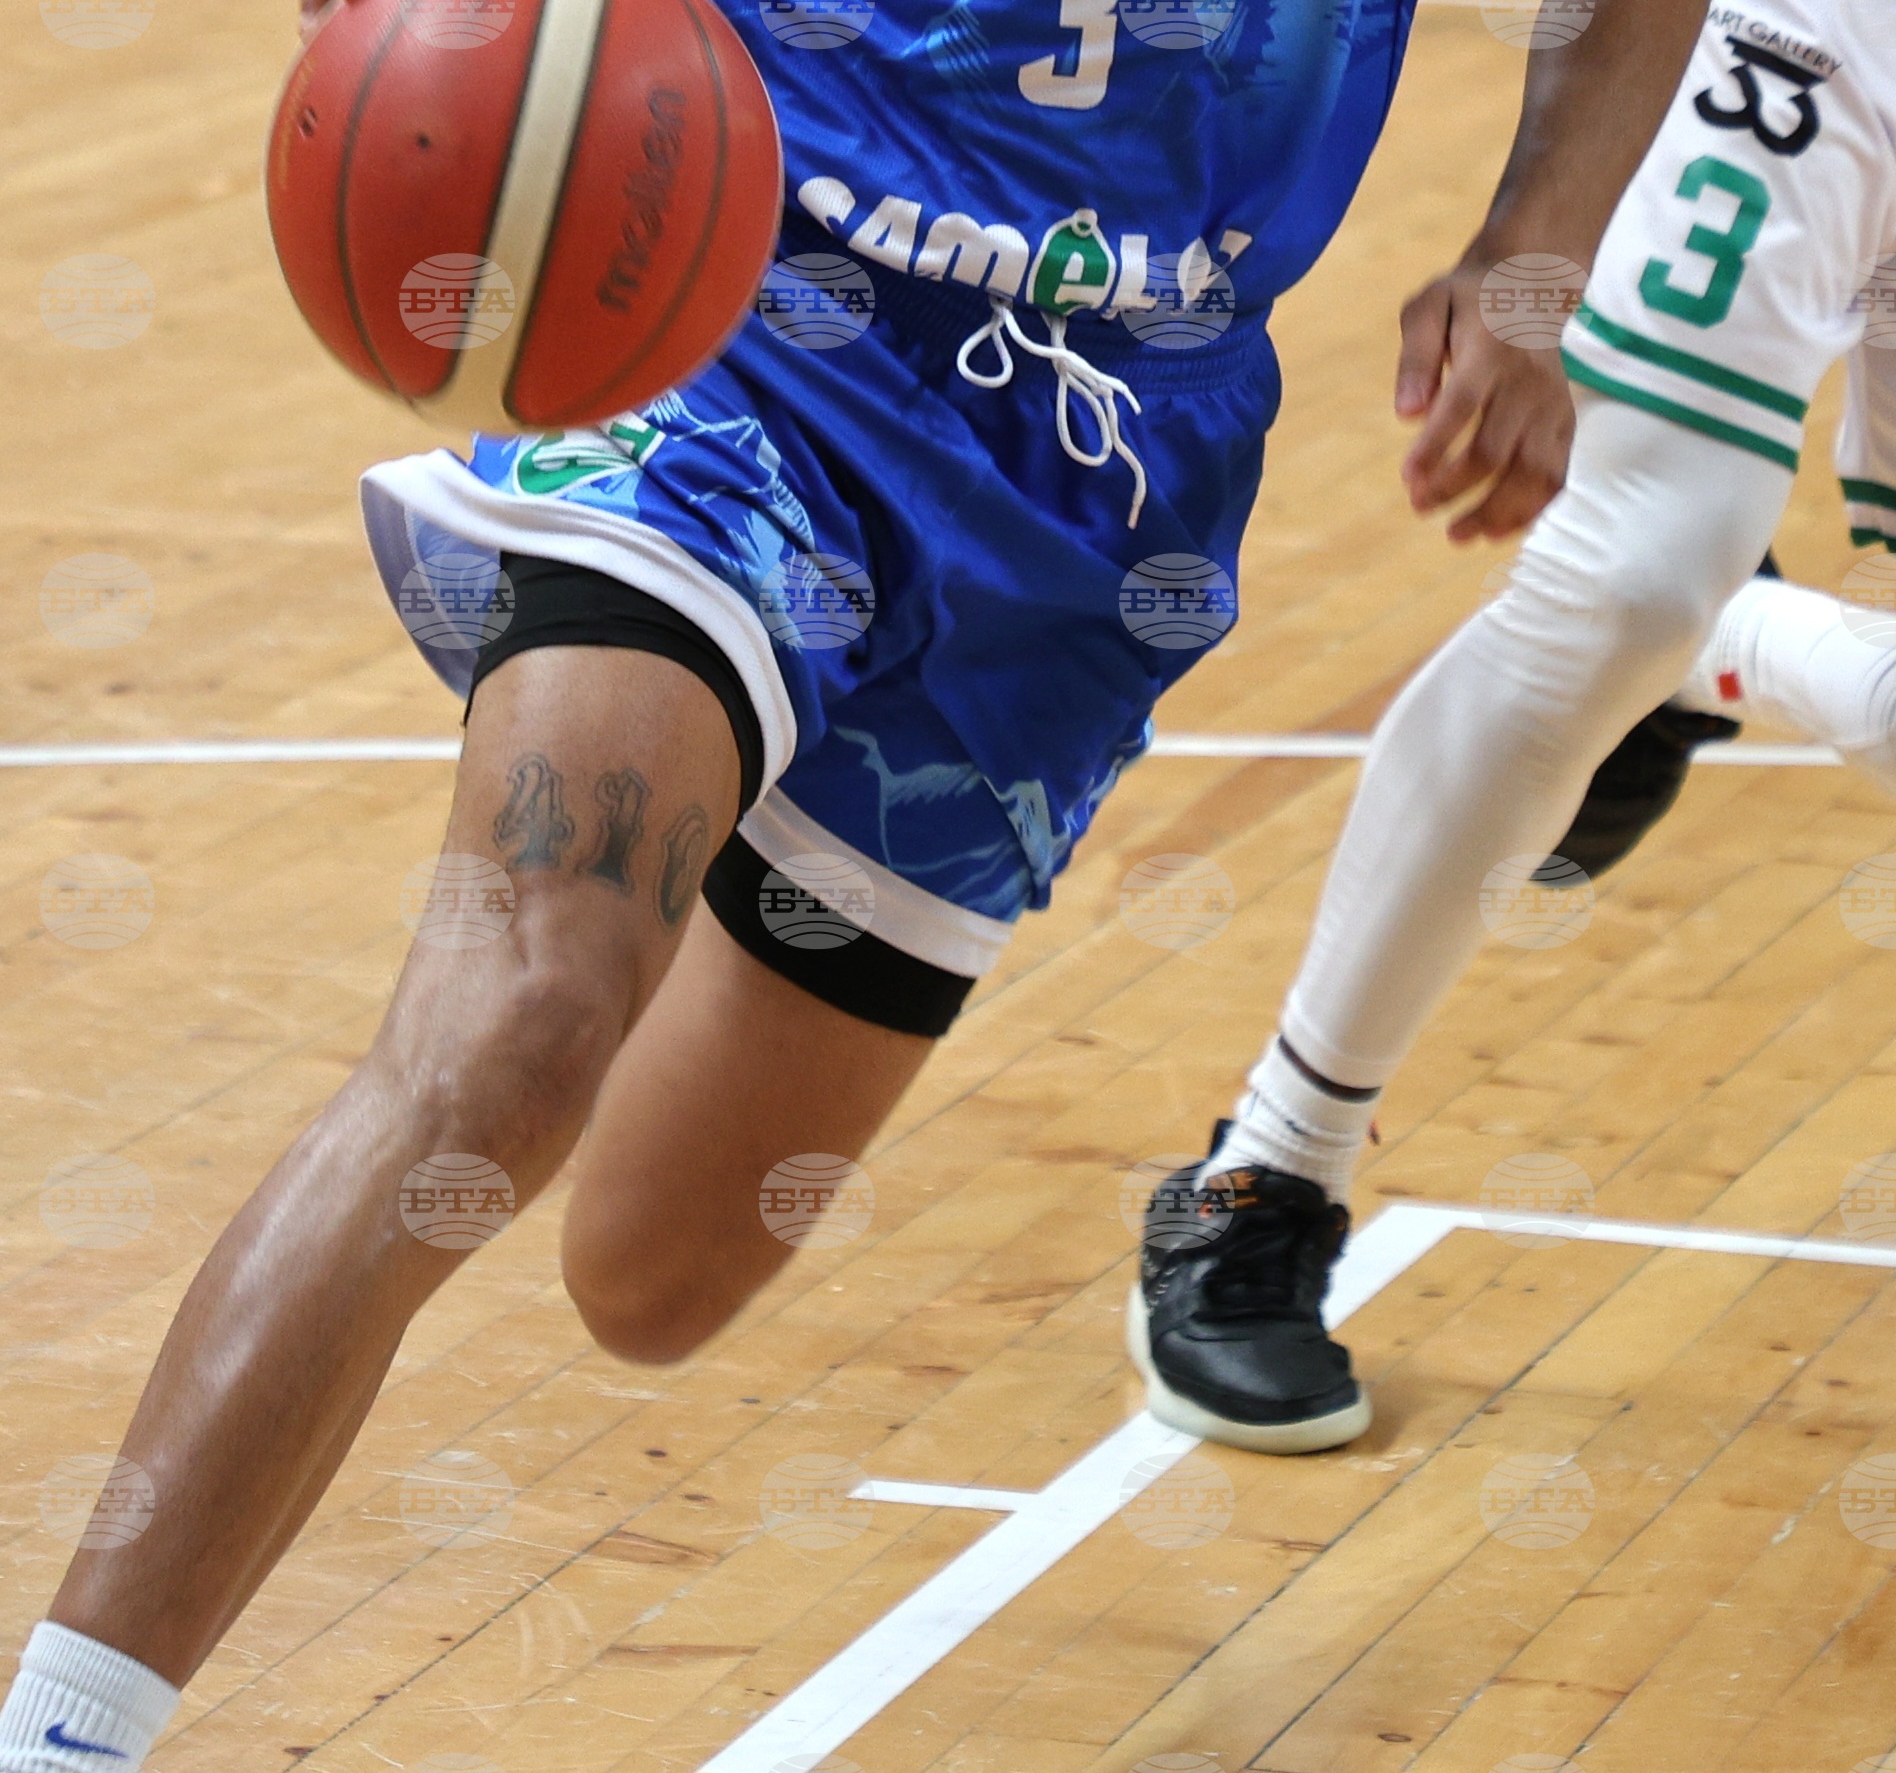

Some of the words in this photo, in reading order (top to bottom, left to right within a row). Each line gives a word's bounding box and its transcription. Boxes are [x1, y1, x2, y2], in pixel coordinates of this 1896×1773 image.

[1708, 7, 1746, 34] ART
[1748, 21, 1843, 76] GALLERY
[1636, 154, 1772, 330] 3
